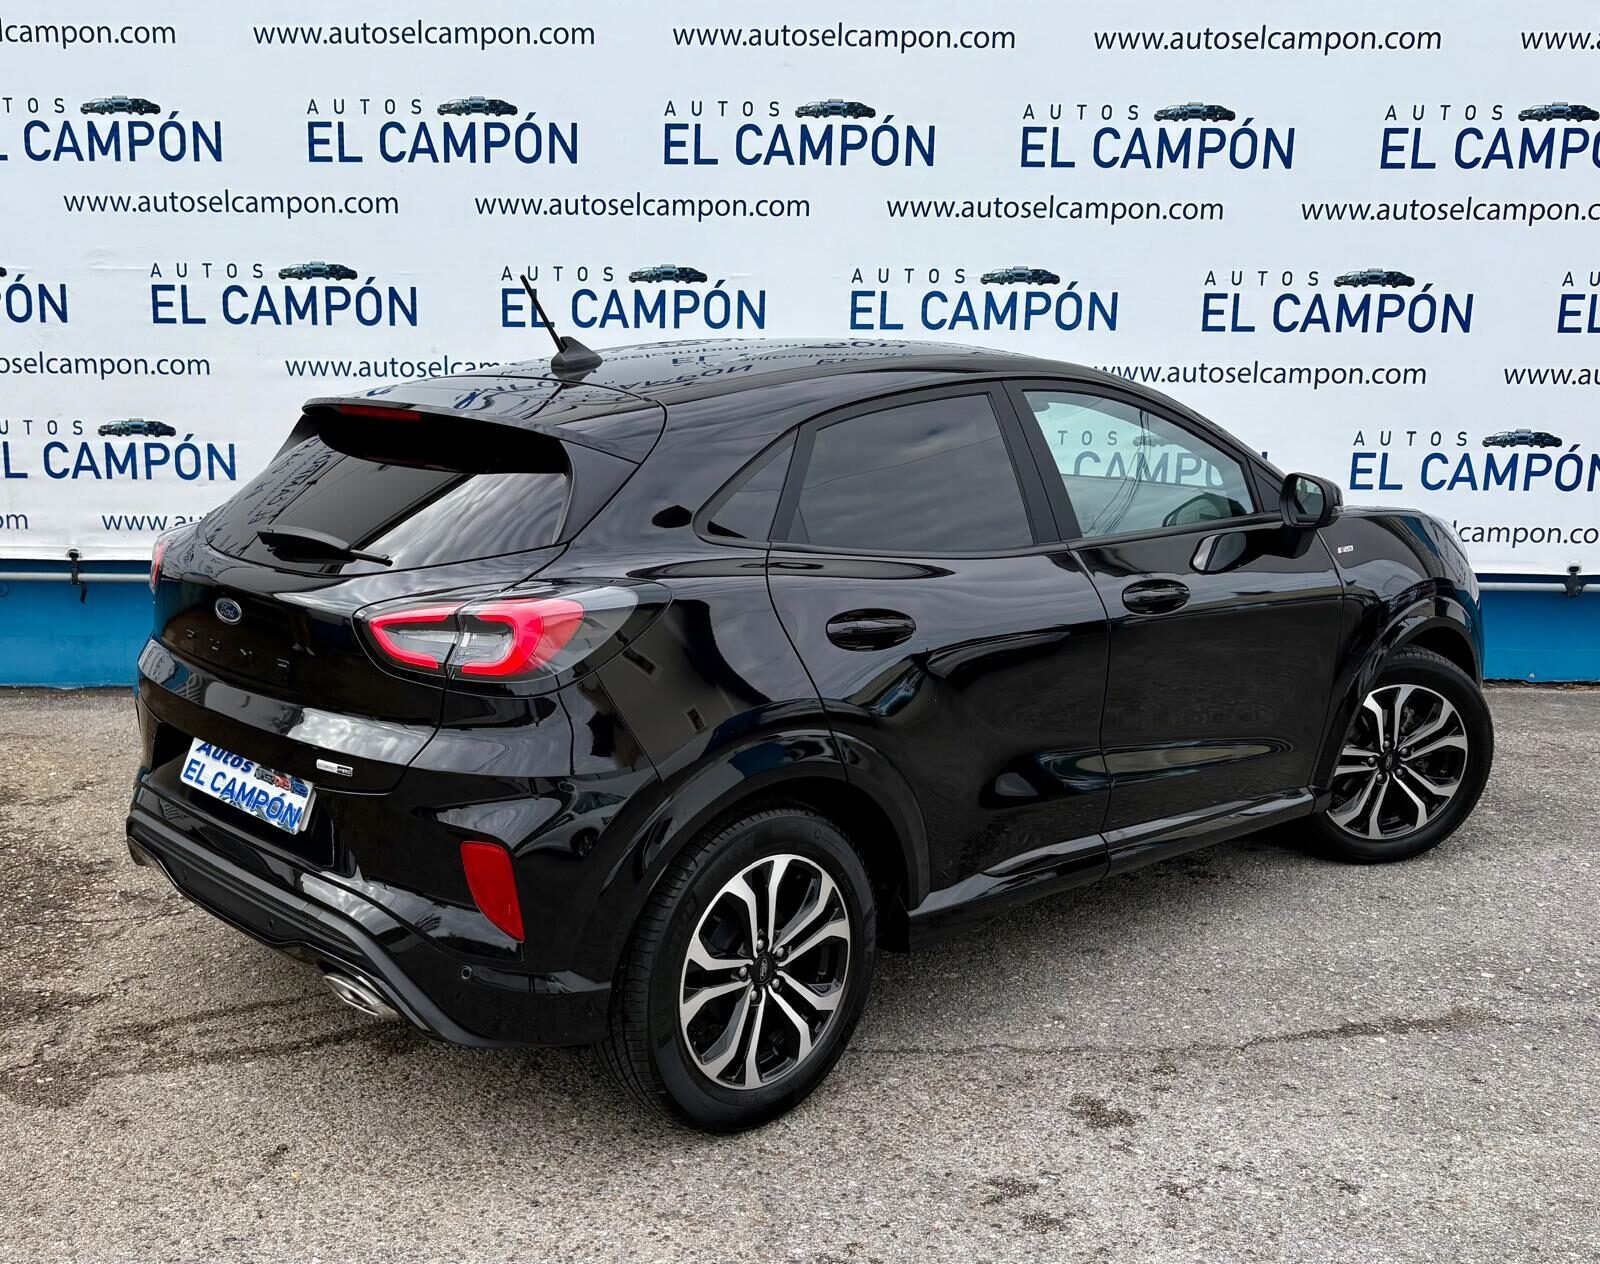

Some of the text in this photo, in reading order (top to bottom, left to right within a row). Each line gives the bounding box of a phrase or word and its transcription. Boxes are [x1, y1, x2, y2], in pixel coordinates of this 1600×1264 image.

[253, 20, 594, 50] www.autoselcampon.com
[673, 22, 1015, 54] www.autoselcampon.com
[1094, 25, 1441, 56] www.autoselcampon.com
[1521, 32, 1600, 49] www.
[307, 99, 421, 114] AUTOS
[664, 100, 779, 117] AUTOS
[1023, 104, 1138, 120] AUTOS
[1385, 105, 1503, 120] AUTOS
[24, 111, 222, 162] CAMPÓN
[308, 112, 577, 164] EL CAMPÓN
[664, 115, 935, 166] EL CAMPÓN
[1021, 117, 1295, 169] EL CAMPÓN
[1380, 127, 1600, 169] EL CAMP
[64, 189, 398, 219] www.autoselcampon.com
[475, 192, 809, 222] www.autoselcampon.com
[887, 195, 1223, 225] www.autoselcampon.com
[1302, 196, 1600, 226] www.autoselcampon.c
[150, 263, 263, 278] AUTOS
[501, 266, 613, 282] AUTOS
[851, 268, 965, 284] AUTOS
[1204, 271, 1318, 286] AUTOS
[0, 273, 68, 323] ÓN
[151, 277, 417, 326] EL CAMPÓN
[502, 280, 765, 329] EL CAMPÓN
[850, 281, 1118, 331] EL CAMPÓN
[1202, 283, 1473, 333] EL CAMPÓN
[1353, 431, 1467, 446] AUTOS
[43, 434, 236, 481] CAMPÓN
[1349, 452, 1403, 490] EL
[183, 758, 303, 828] EL CAMPÓN
